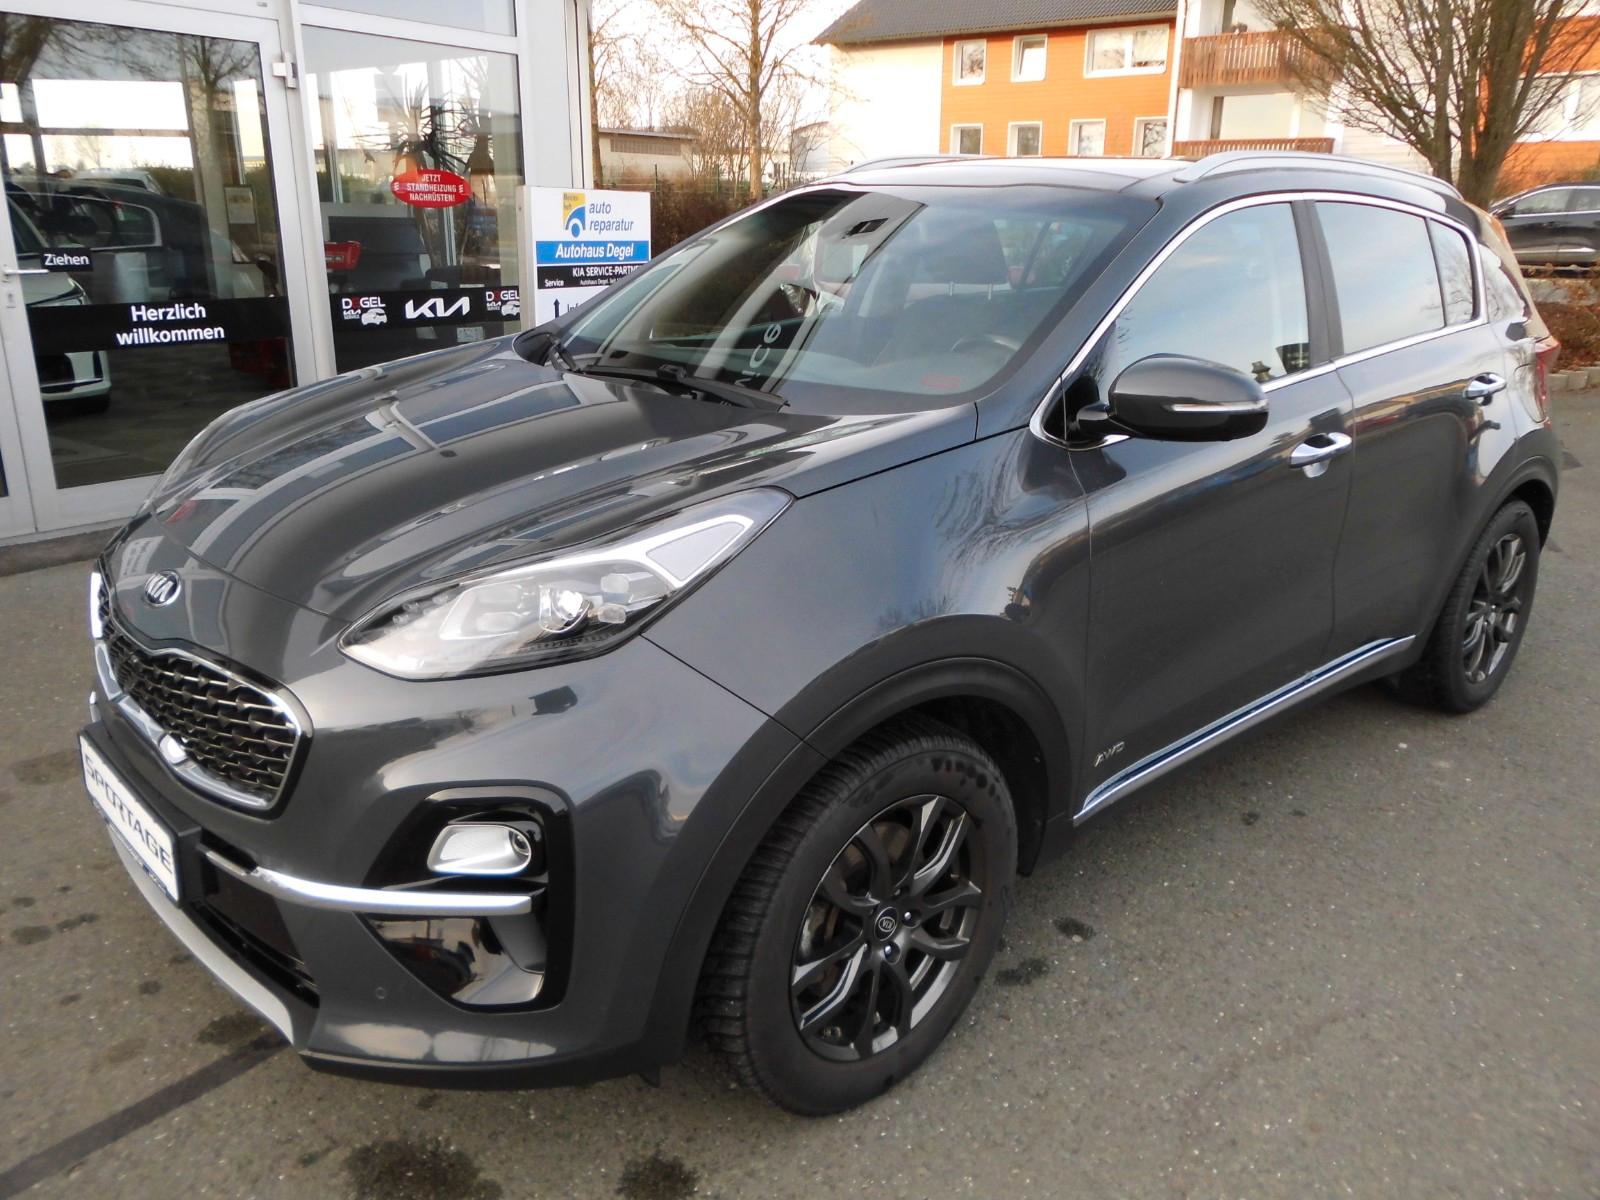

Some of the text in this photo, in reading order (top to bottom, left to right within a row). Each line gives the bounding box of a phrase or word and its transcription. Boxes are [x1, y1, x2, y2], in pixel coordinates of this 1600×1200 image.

[422, 174, 441, 182] JETZT
[407, 183, 457, 193] STANDHEIZUNG
[410, 192, 456, 202] NACHRÜSTEN!
[589, 202, 612, 214] auto
[589, 219, 634, 234] reparatur
[555, 243, 634, 260] Autohaus Degel
[44, 253, 90, 266] Ziehen
[572, 267, 585, 278] KIA
[544, 279, 565, 288] Service
[131, 303, 207, 322] Herzlich
[405, 296, 471, 319] KIA
[116, 326, 226, 346] willkommen
[84, 753, 173, 874] SPORTAGE
